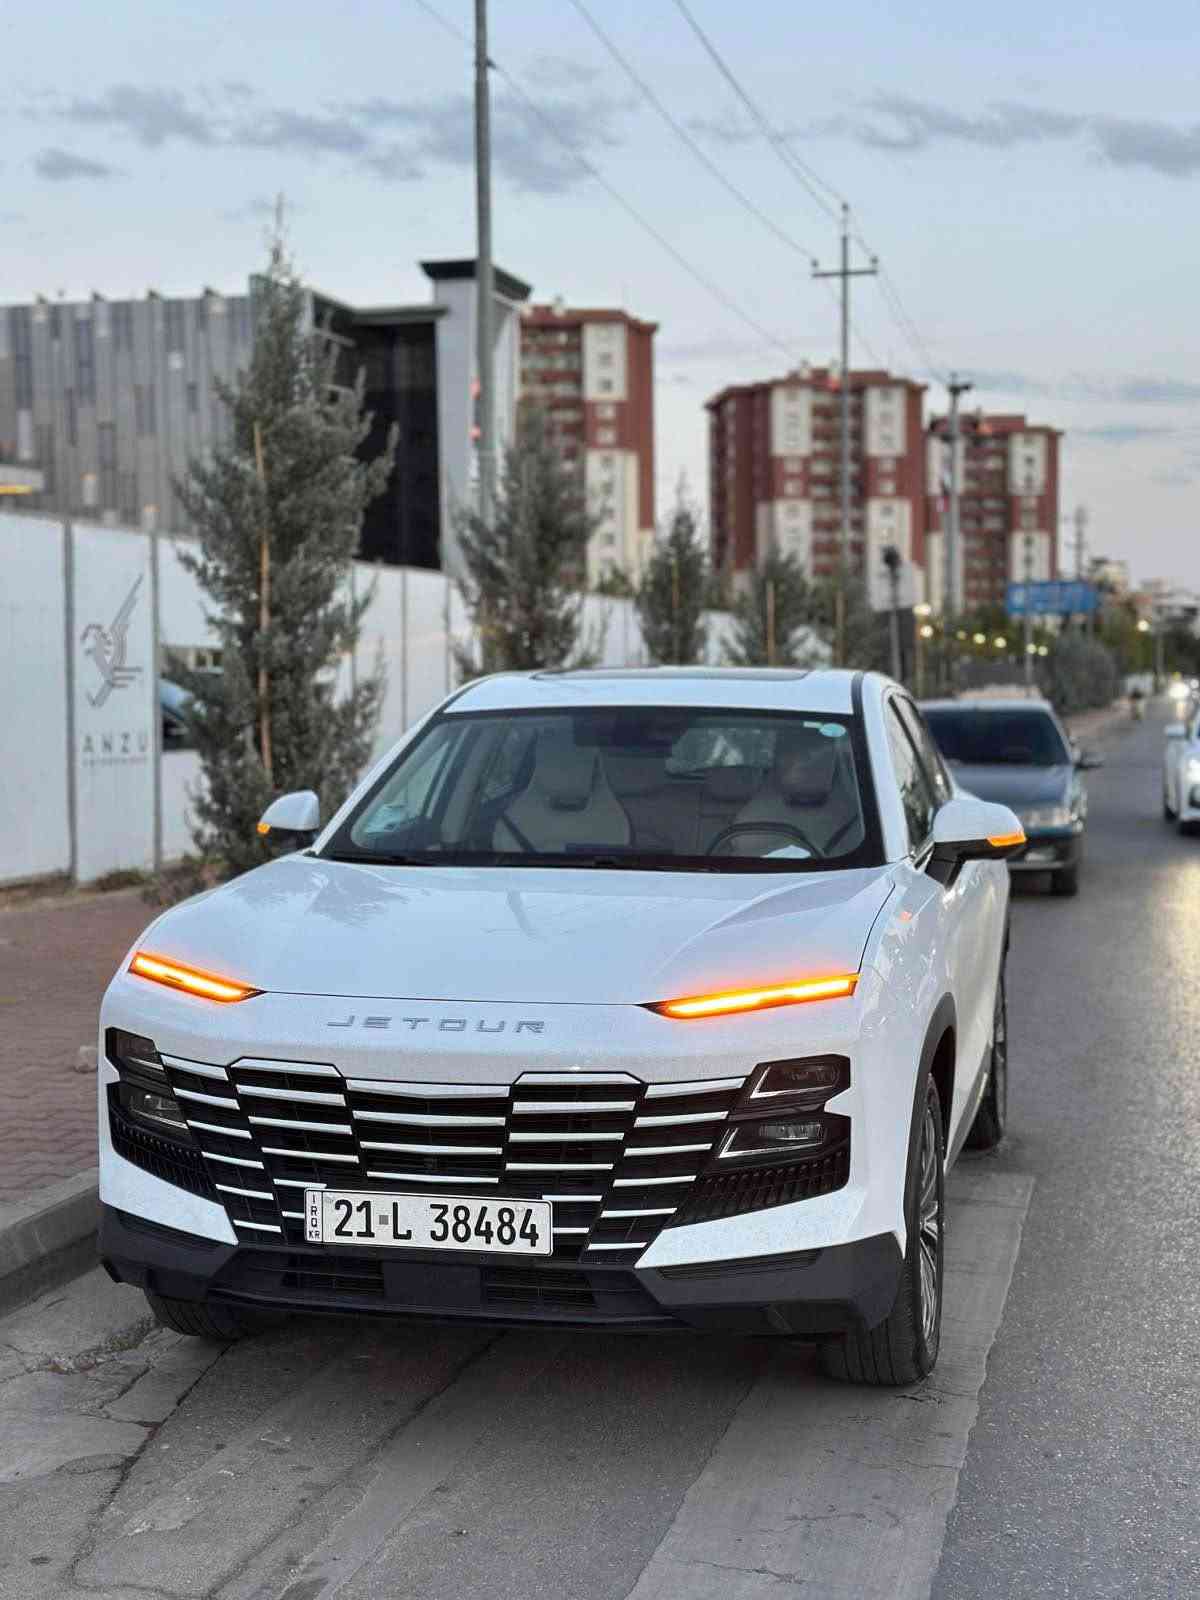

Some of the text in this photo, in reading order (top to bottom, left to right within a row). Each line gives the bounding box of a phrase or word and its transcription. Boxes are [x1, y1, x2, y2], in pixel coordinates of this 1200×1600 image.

[83, 732, 148, 753] ANZU
[327, 1015, 546, 1033] JETOUR
[333, 1199, 539, 1247] 21 L 38484
